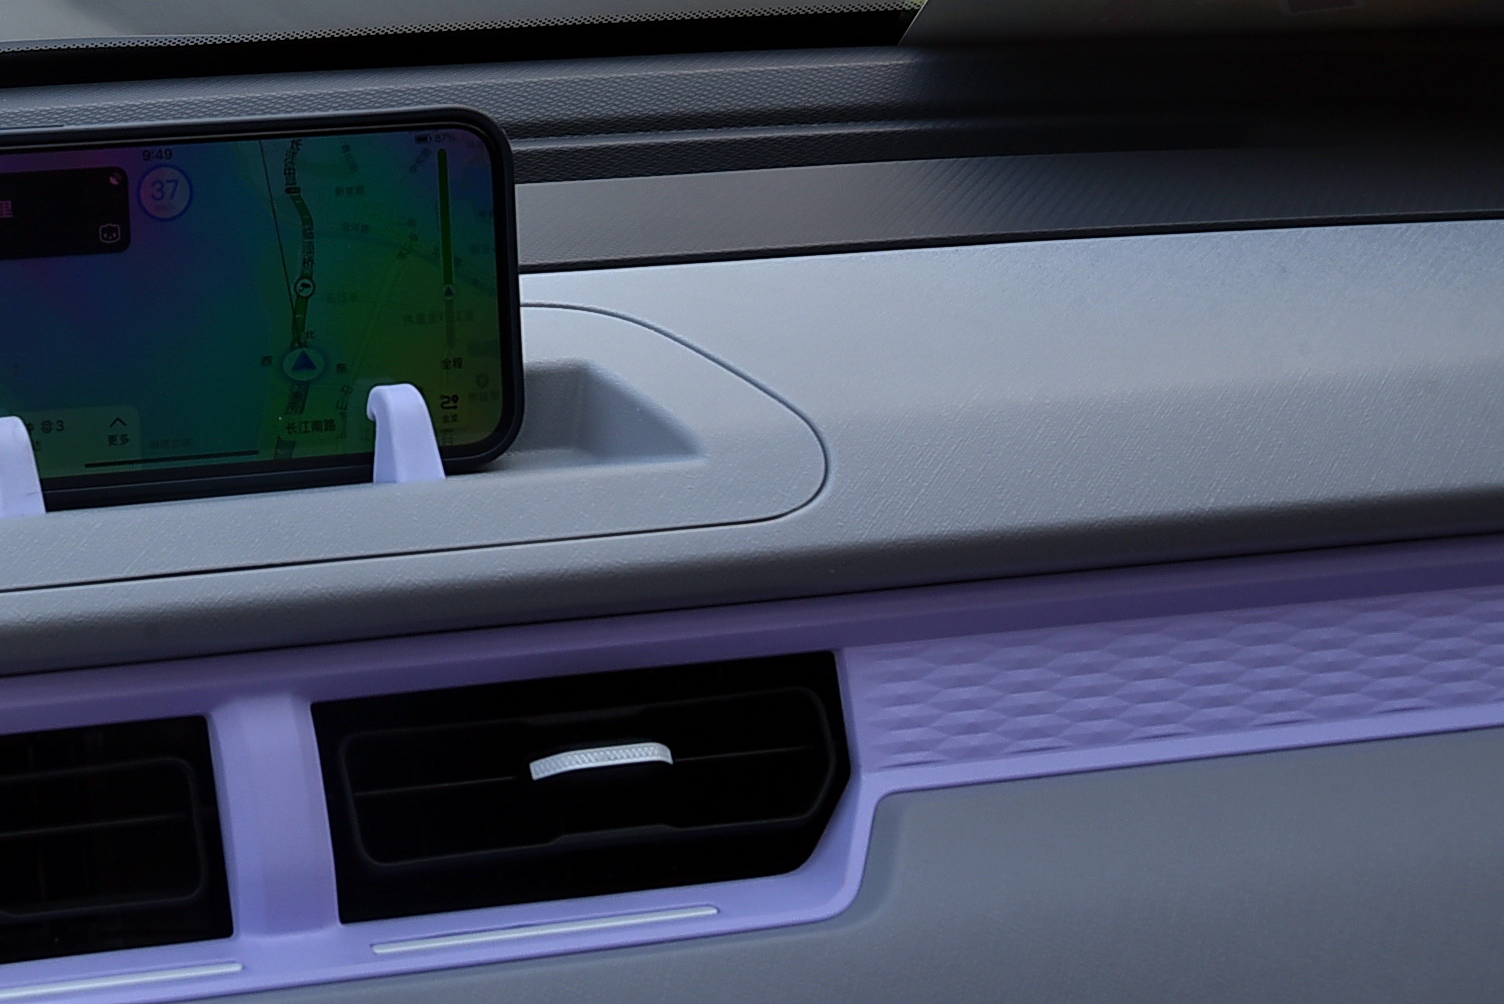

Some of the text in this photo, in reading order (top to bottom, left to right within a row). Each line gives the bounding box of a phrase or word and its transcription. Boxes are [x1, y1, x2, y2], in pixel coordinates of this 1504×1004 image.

[142, 148, 173, 161] 9:49
[152, 179, 179, 201] 37
[285, 419, 336, 434] 长江南路
